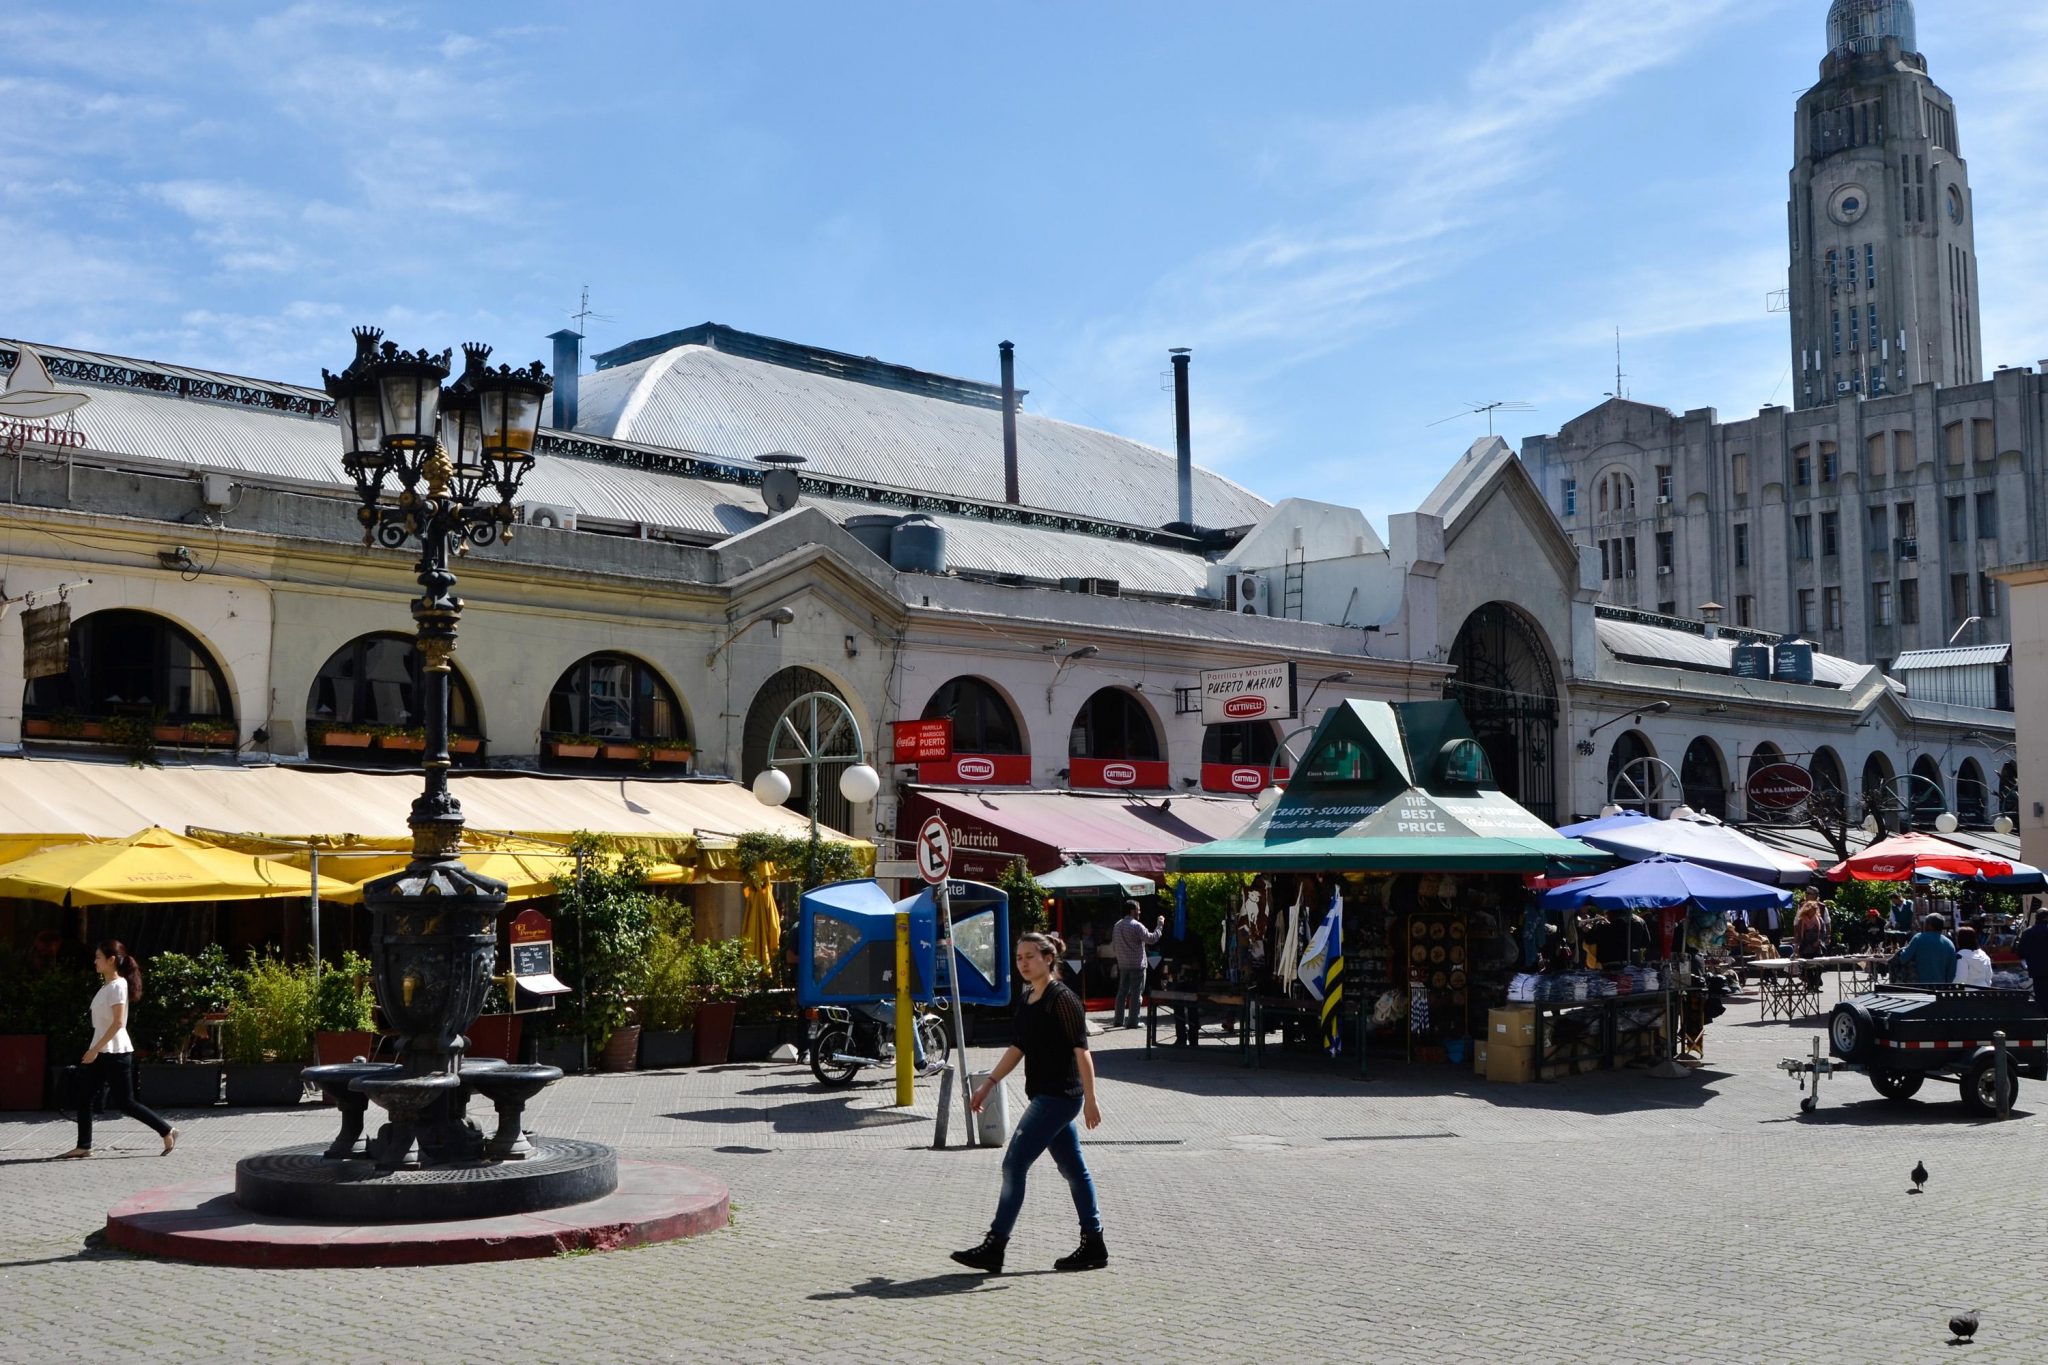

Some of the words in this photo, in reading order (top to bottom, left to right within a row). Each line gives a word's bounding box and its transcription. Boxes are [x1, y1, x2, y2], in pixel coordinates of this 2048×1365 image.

[1207, 672, 1237, 680] Parrilla
[1246, 667, 1282, 677] Mariscos
[1207, 680, 1244, 694] PUERTO
[1245, 676, 1283, 692] MARINO
[920, 738, 945, 746] PUERTO
[920, 748, 945, 757] MARINO
[1405, 796, 1427, 807] THE
[1272, 807, 1315, 817] CRAFTS
[1318, 805, 1386, 816] SOUVENIRS
[1401, 809, 1436, 820] BEST
[1398, 822, 1446, 833] PRICE
[951, 827, 999, 847] Patricia
